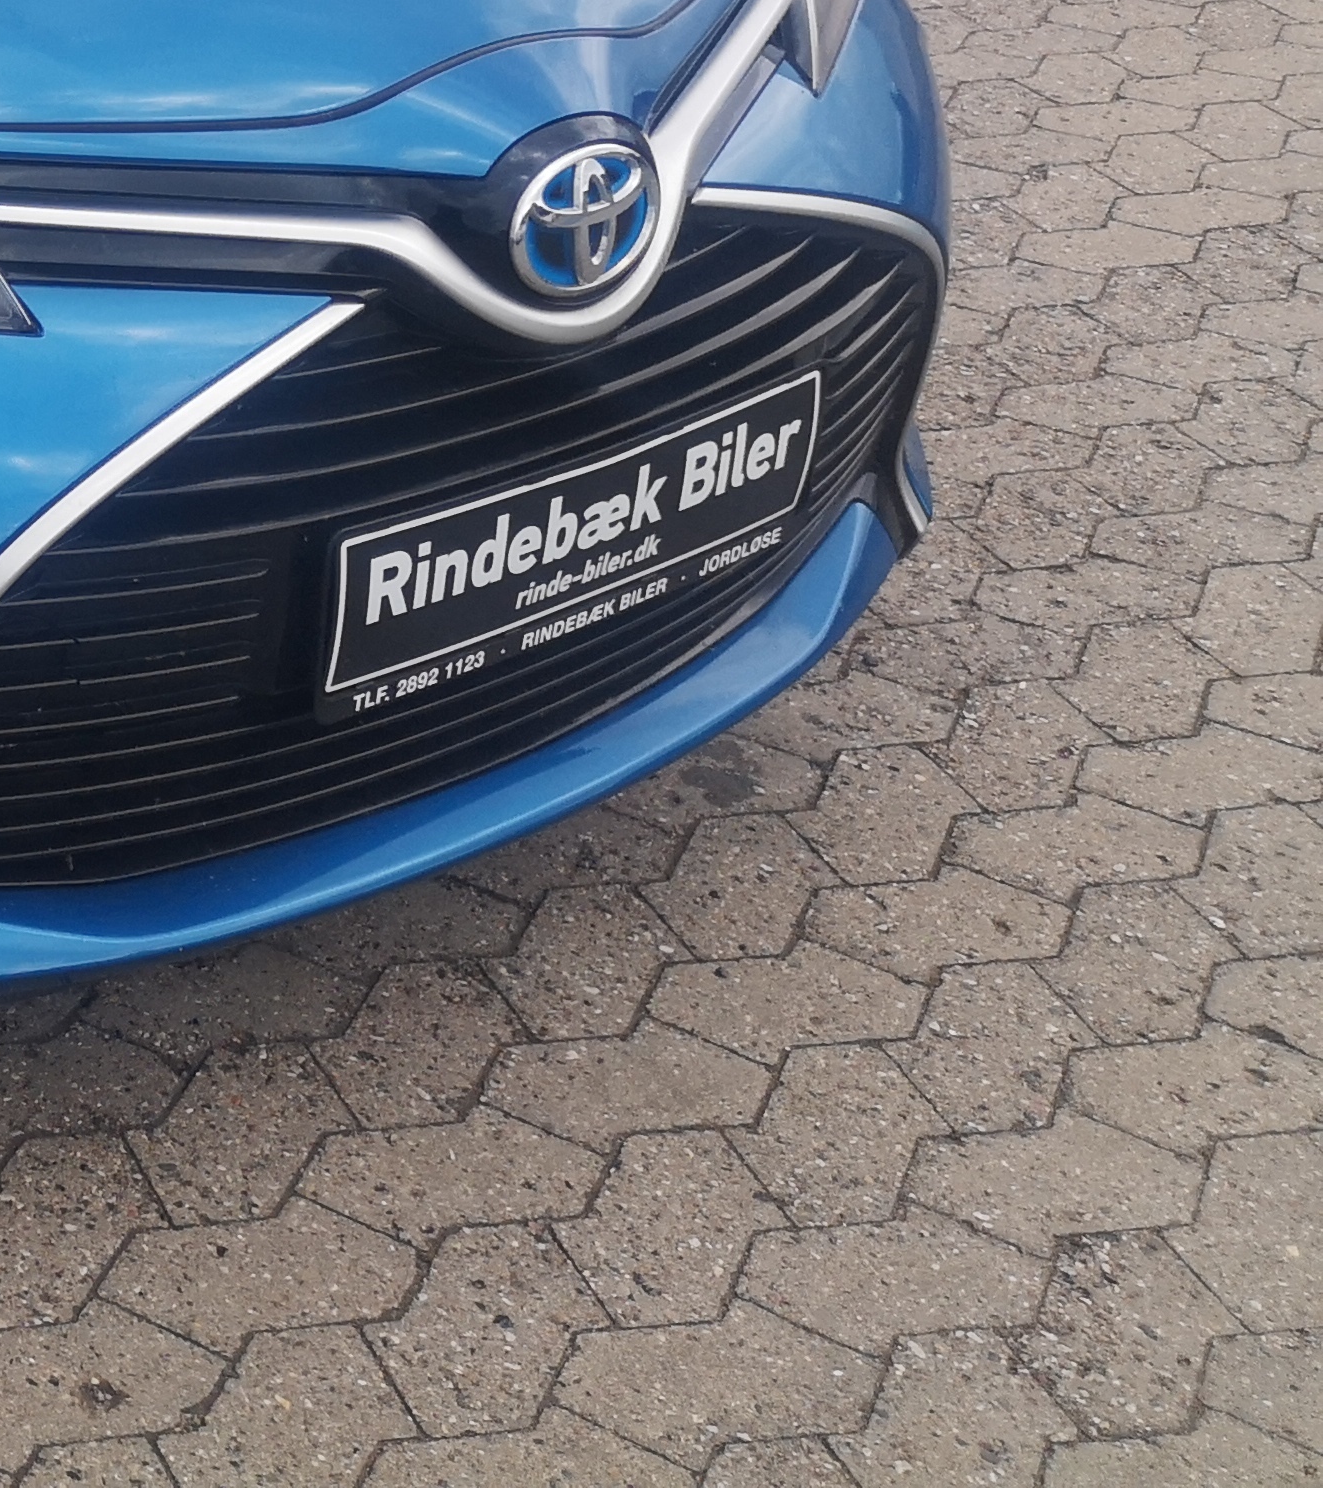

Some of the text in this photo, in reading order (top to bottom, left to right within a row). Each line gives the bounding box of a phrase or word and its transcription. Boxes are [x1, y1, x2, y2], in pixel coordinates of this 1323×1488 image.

[365, 418, 802, 626] Rindebæk Biler
[514, 533, 662, 610] rinde-biler.dk
[353, 526, 783, 712] TLF. 2892 1123 RINDEBÆK BILER JORDLØSE
